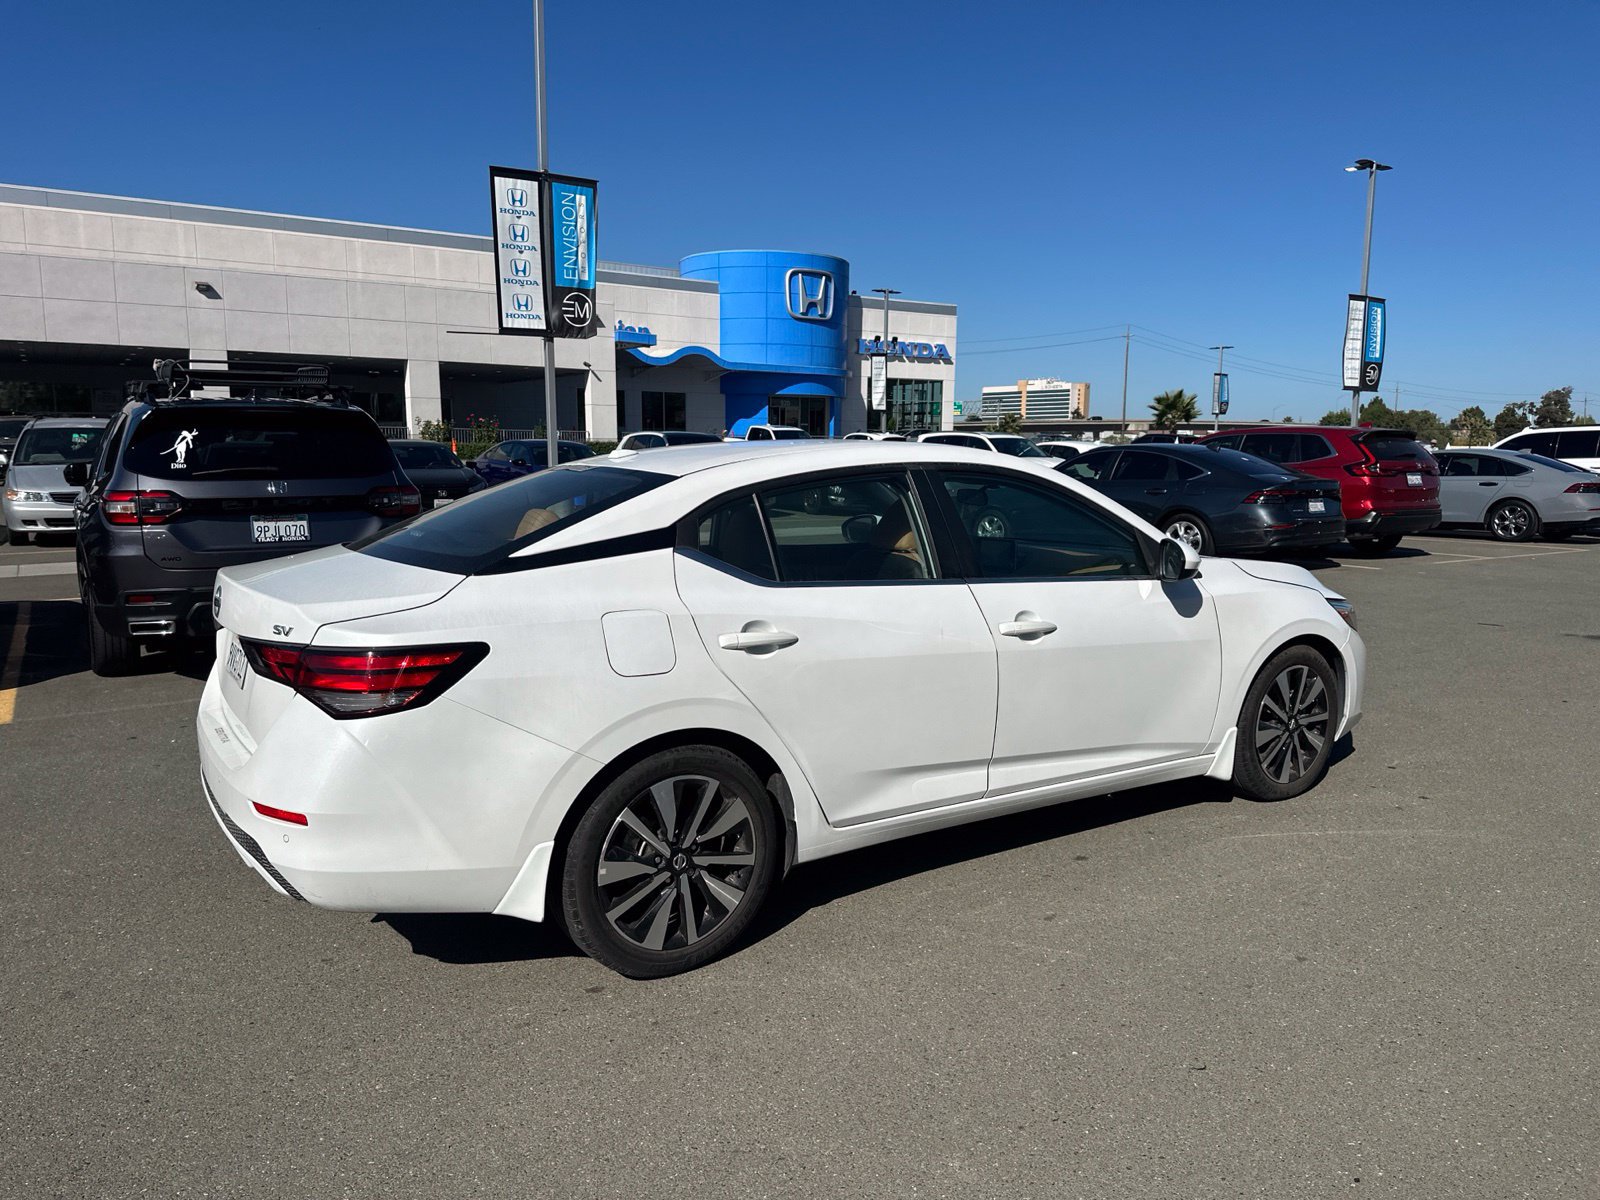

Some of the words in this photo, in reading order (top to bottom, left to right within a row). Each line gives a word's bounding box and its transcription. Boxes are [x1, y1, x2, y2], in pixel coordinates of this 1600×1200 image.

[499, 207, 536, 217] HONDA
[561, 191, 579, 281] ENVISION
[578, 202, 588, 274] MOTORS
[501, 243, 537, 251] HONDA
[503, 278, 540, 286] HONDA
[614, 319, 651, 334] ion
[1369, 306, 1378, 358] ENVISION
[256, 524, 306, 538] 9PJL070
[272, 624, 294, 637] SV
